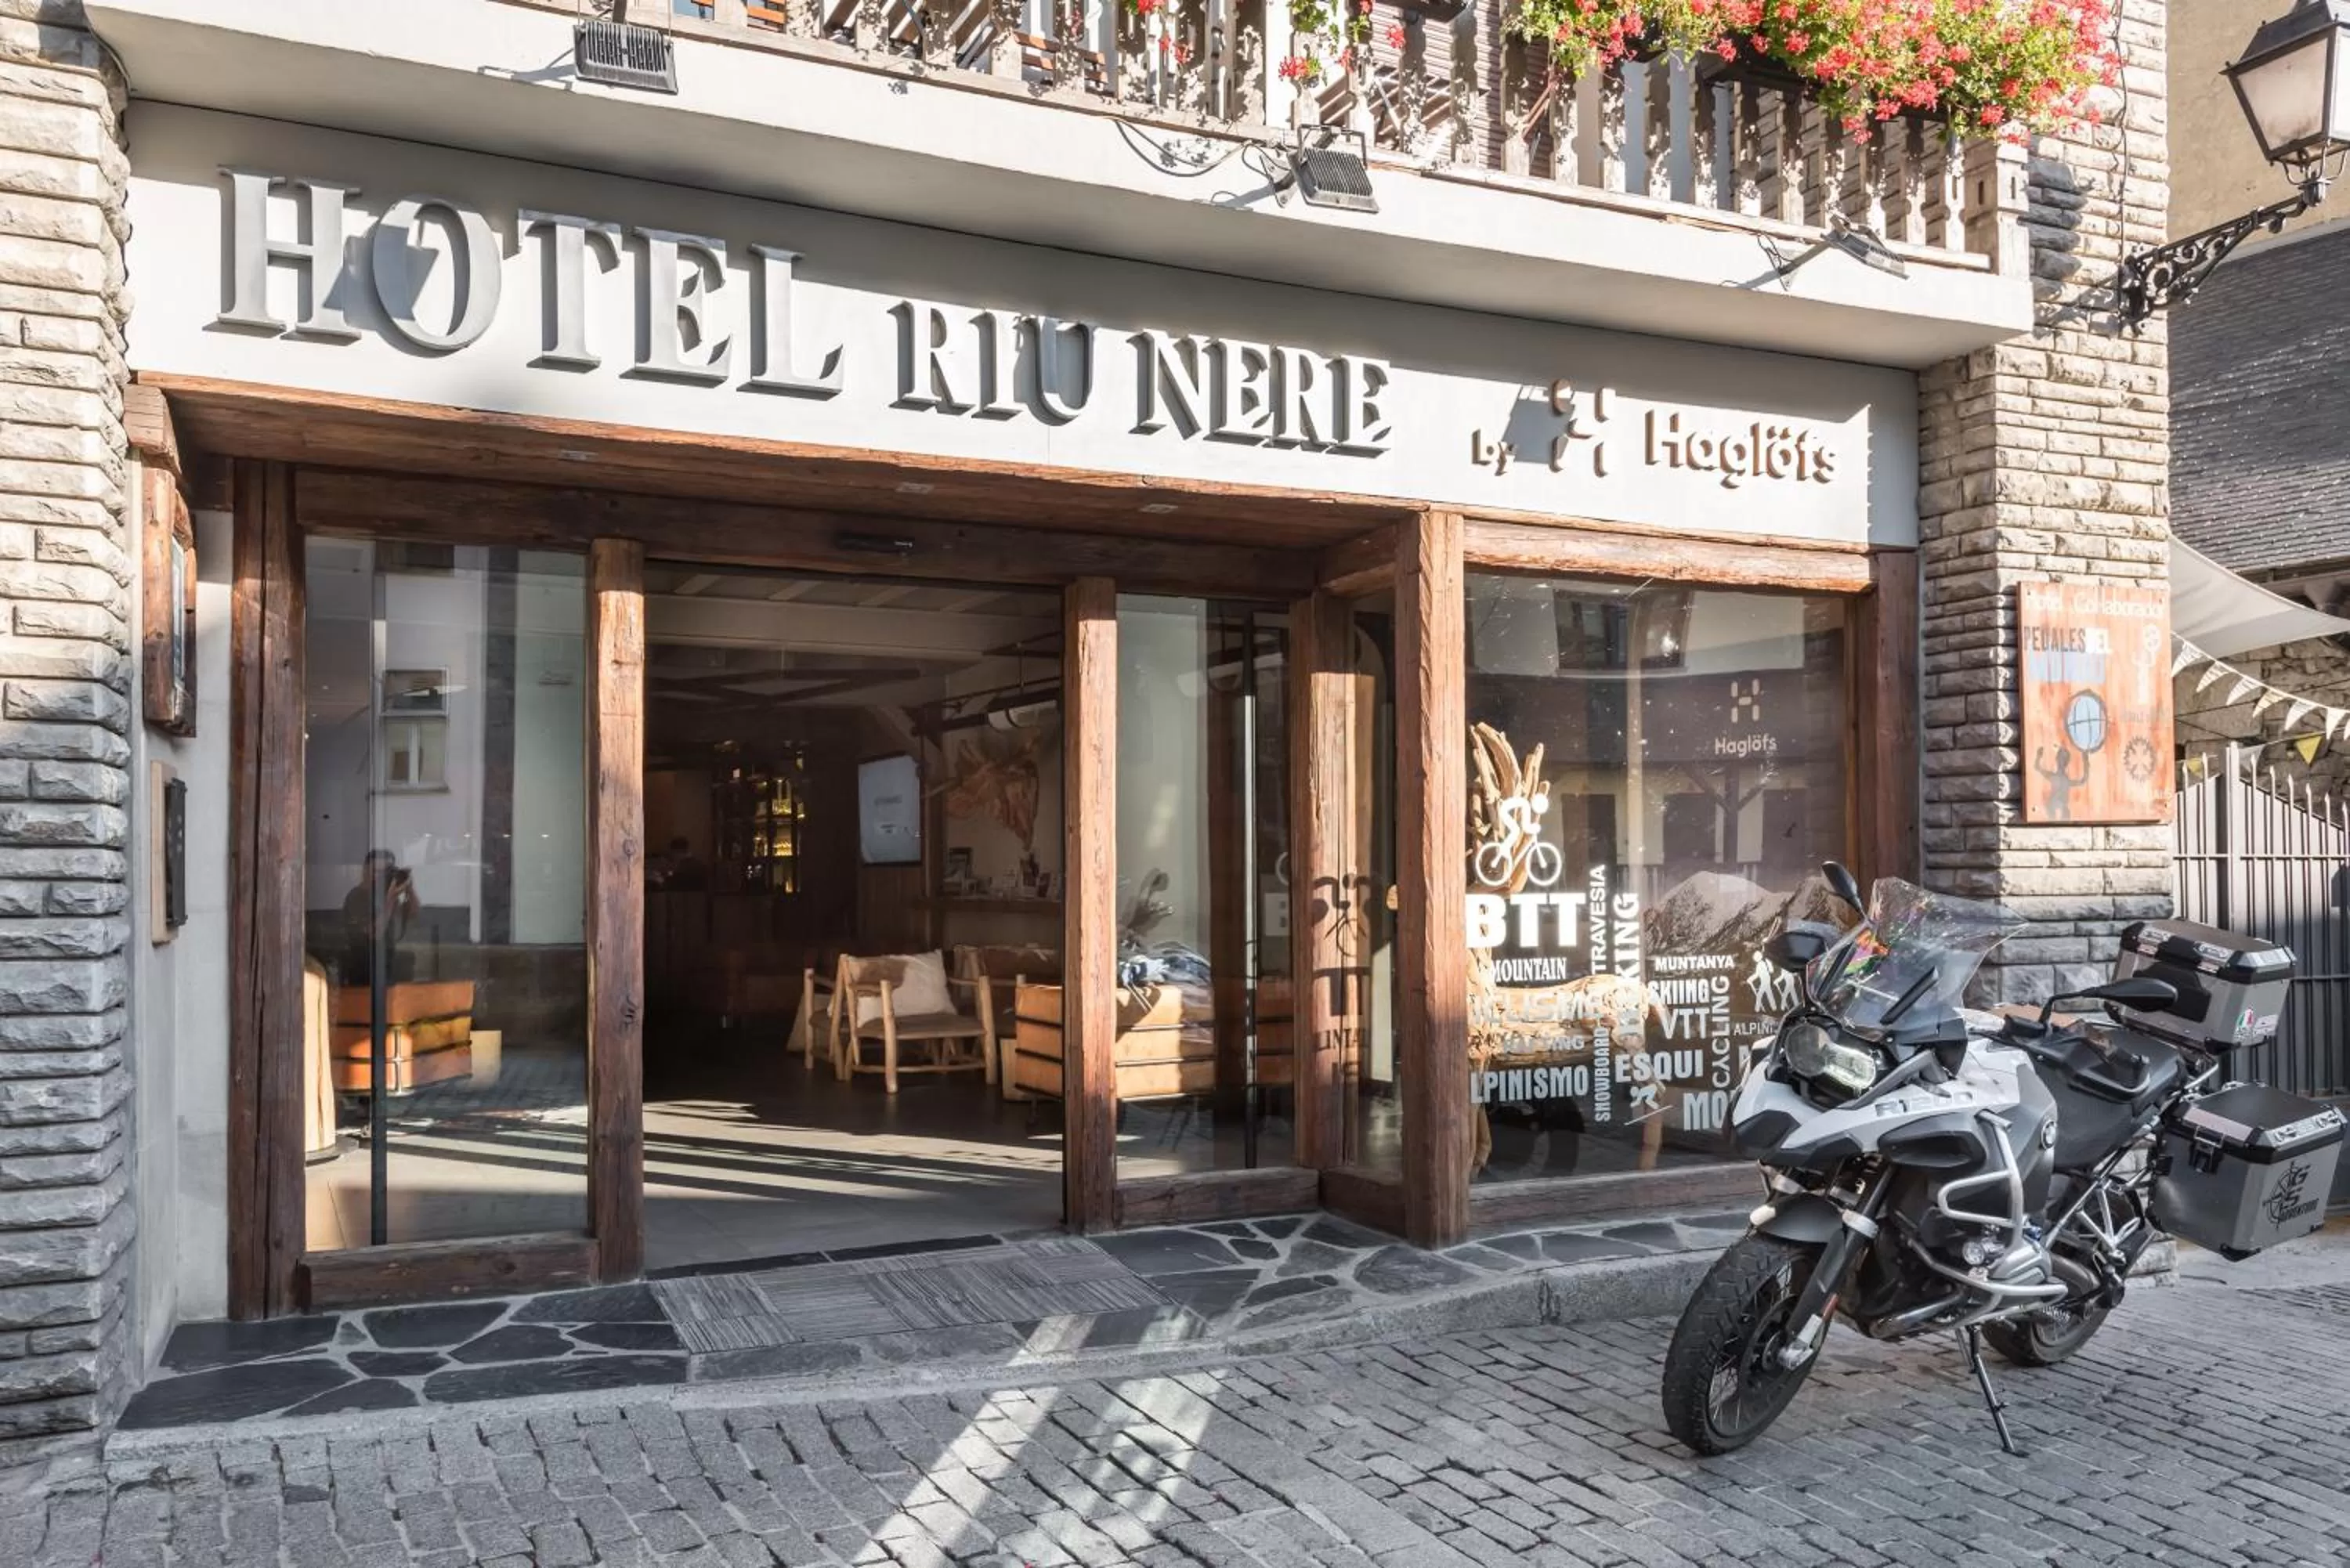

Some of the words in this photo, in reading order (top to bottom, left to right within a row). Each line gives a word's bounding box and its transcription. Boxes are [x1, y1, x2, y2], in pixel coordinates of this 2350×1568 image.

[210, 164, 845, 396] HOTEL
[890, 301, 1095, 423] RIU
[1128, 330, 1390, 453] NERE
[1472, 428, 1517, 476] by
[1645, 409, 1836, 489] Haglöfs
[2024, 626, 2085, 653] PEDALES
[1715, 732, 1777, 758] Haglöfs
[1465, 892, 1586, 948] BTT
[1589, 864, 1607, 976] TRAVESIA
[1490, 956, 1567, 982] MOUNTAIN
[1655, 954, 1736, 972] MUNTANYA
[1647, 978, 1711, 1006] SKIING
[1661, 1008, 1710, 1040] VTT
[1711, 975, 1730, 1089] CYCLING
[1593, 1027, 1611, 1122] SNOWBOARD
[1614, 1049, 1704, 1084] ESQUI
